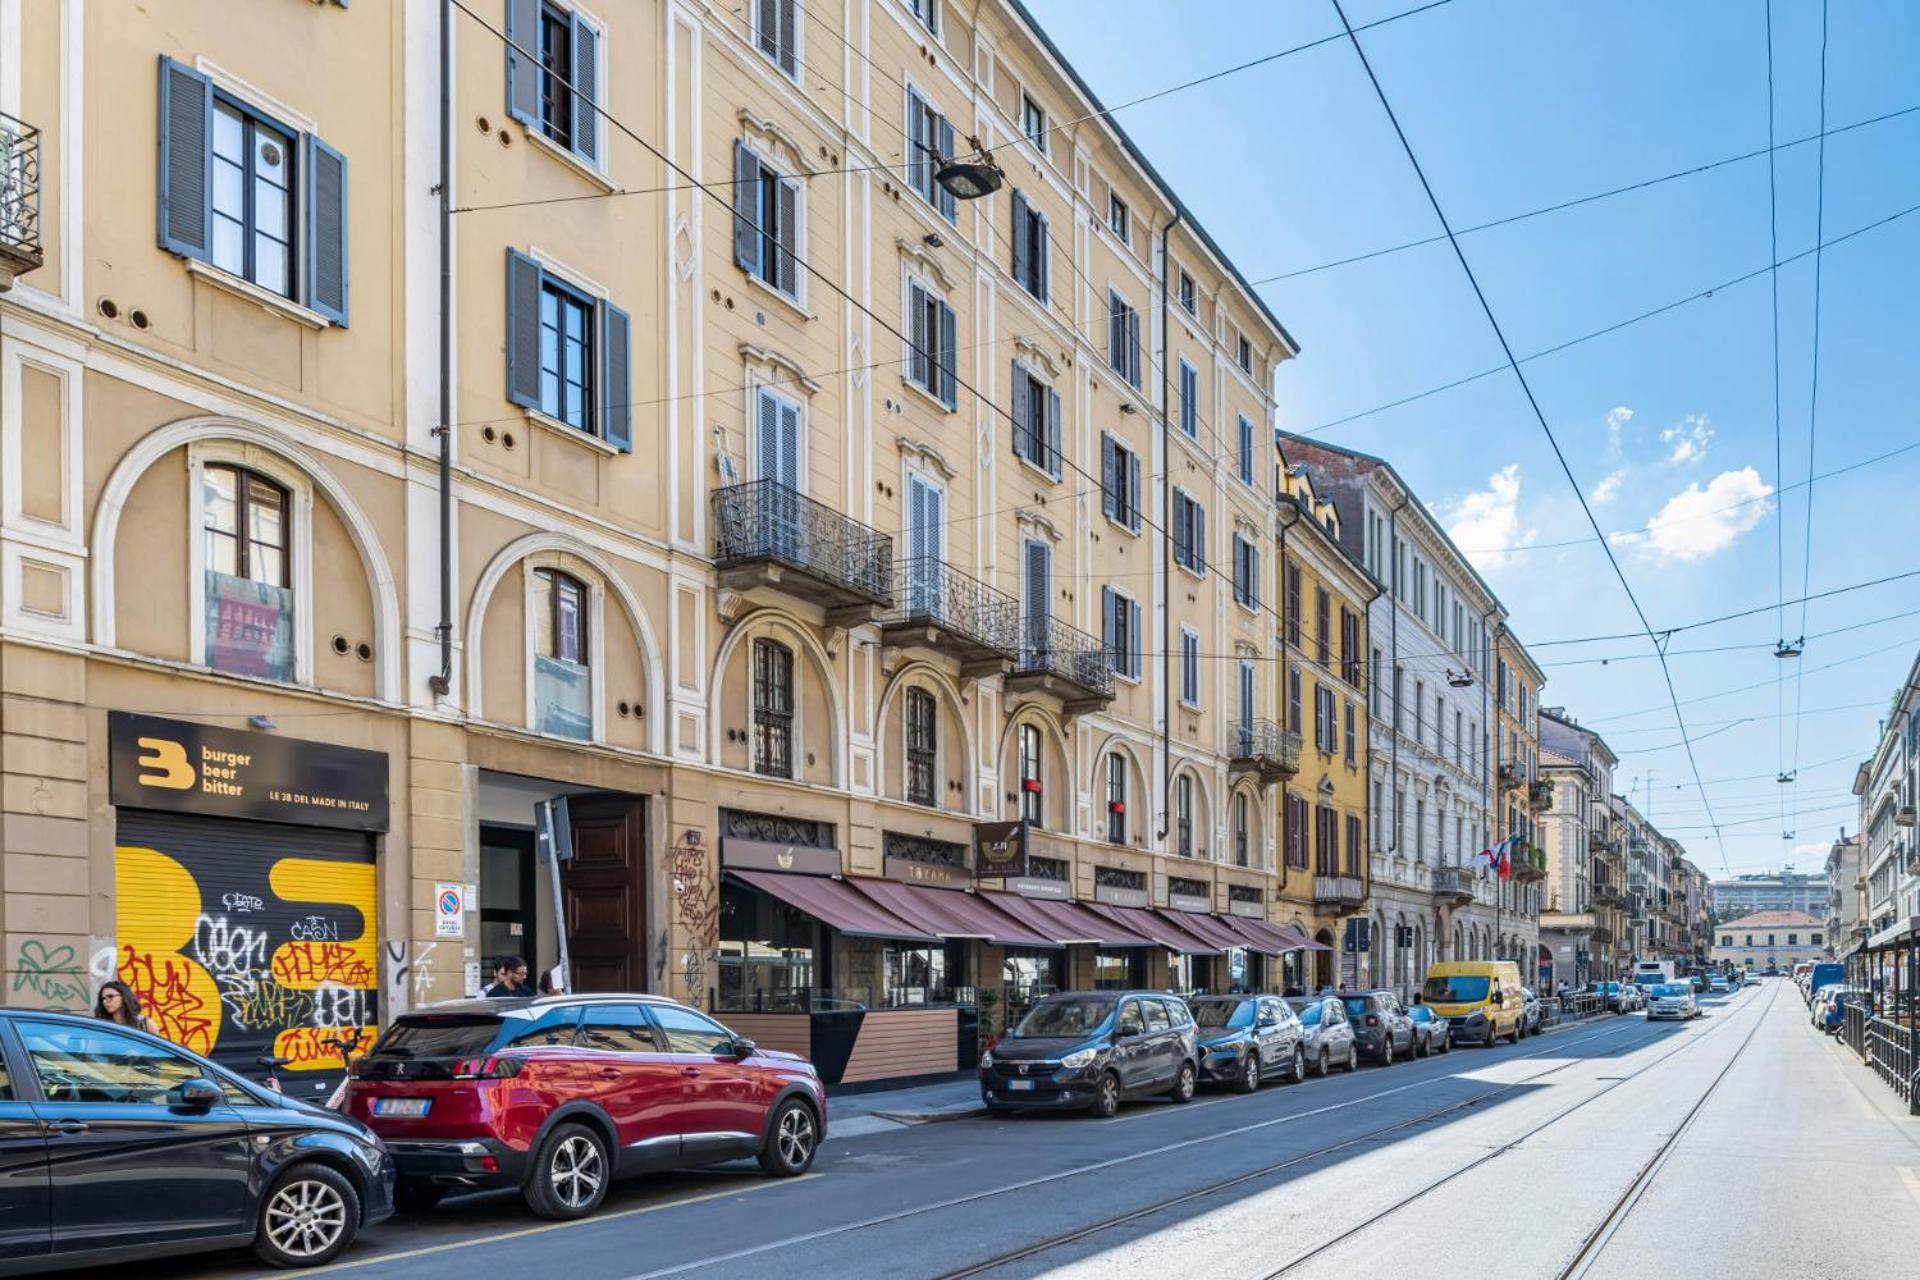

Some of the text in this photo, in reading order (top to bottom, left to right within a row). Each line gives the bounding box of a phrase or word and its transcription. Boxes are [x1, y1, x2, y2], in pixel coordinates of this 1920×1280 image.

[202, 746, 251, 766] burger
[202, 764, 237, 780] beer
[202, 779, 243, 796] bitter
[269, 791, 280, 801] LE
[293, 794, 309, 804] DEL
[311, 796, 336, 807] MADE
[337, 799, 347, 809] IN
[348, 800, 369, 811] ITALY
